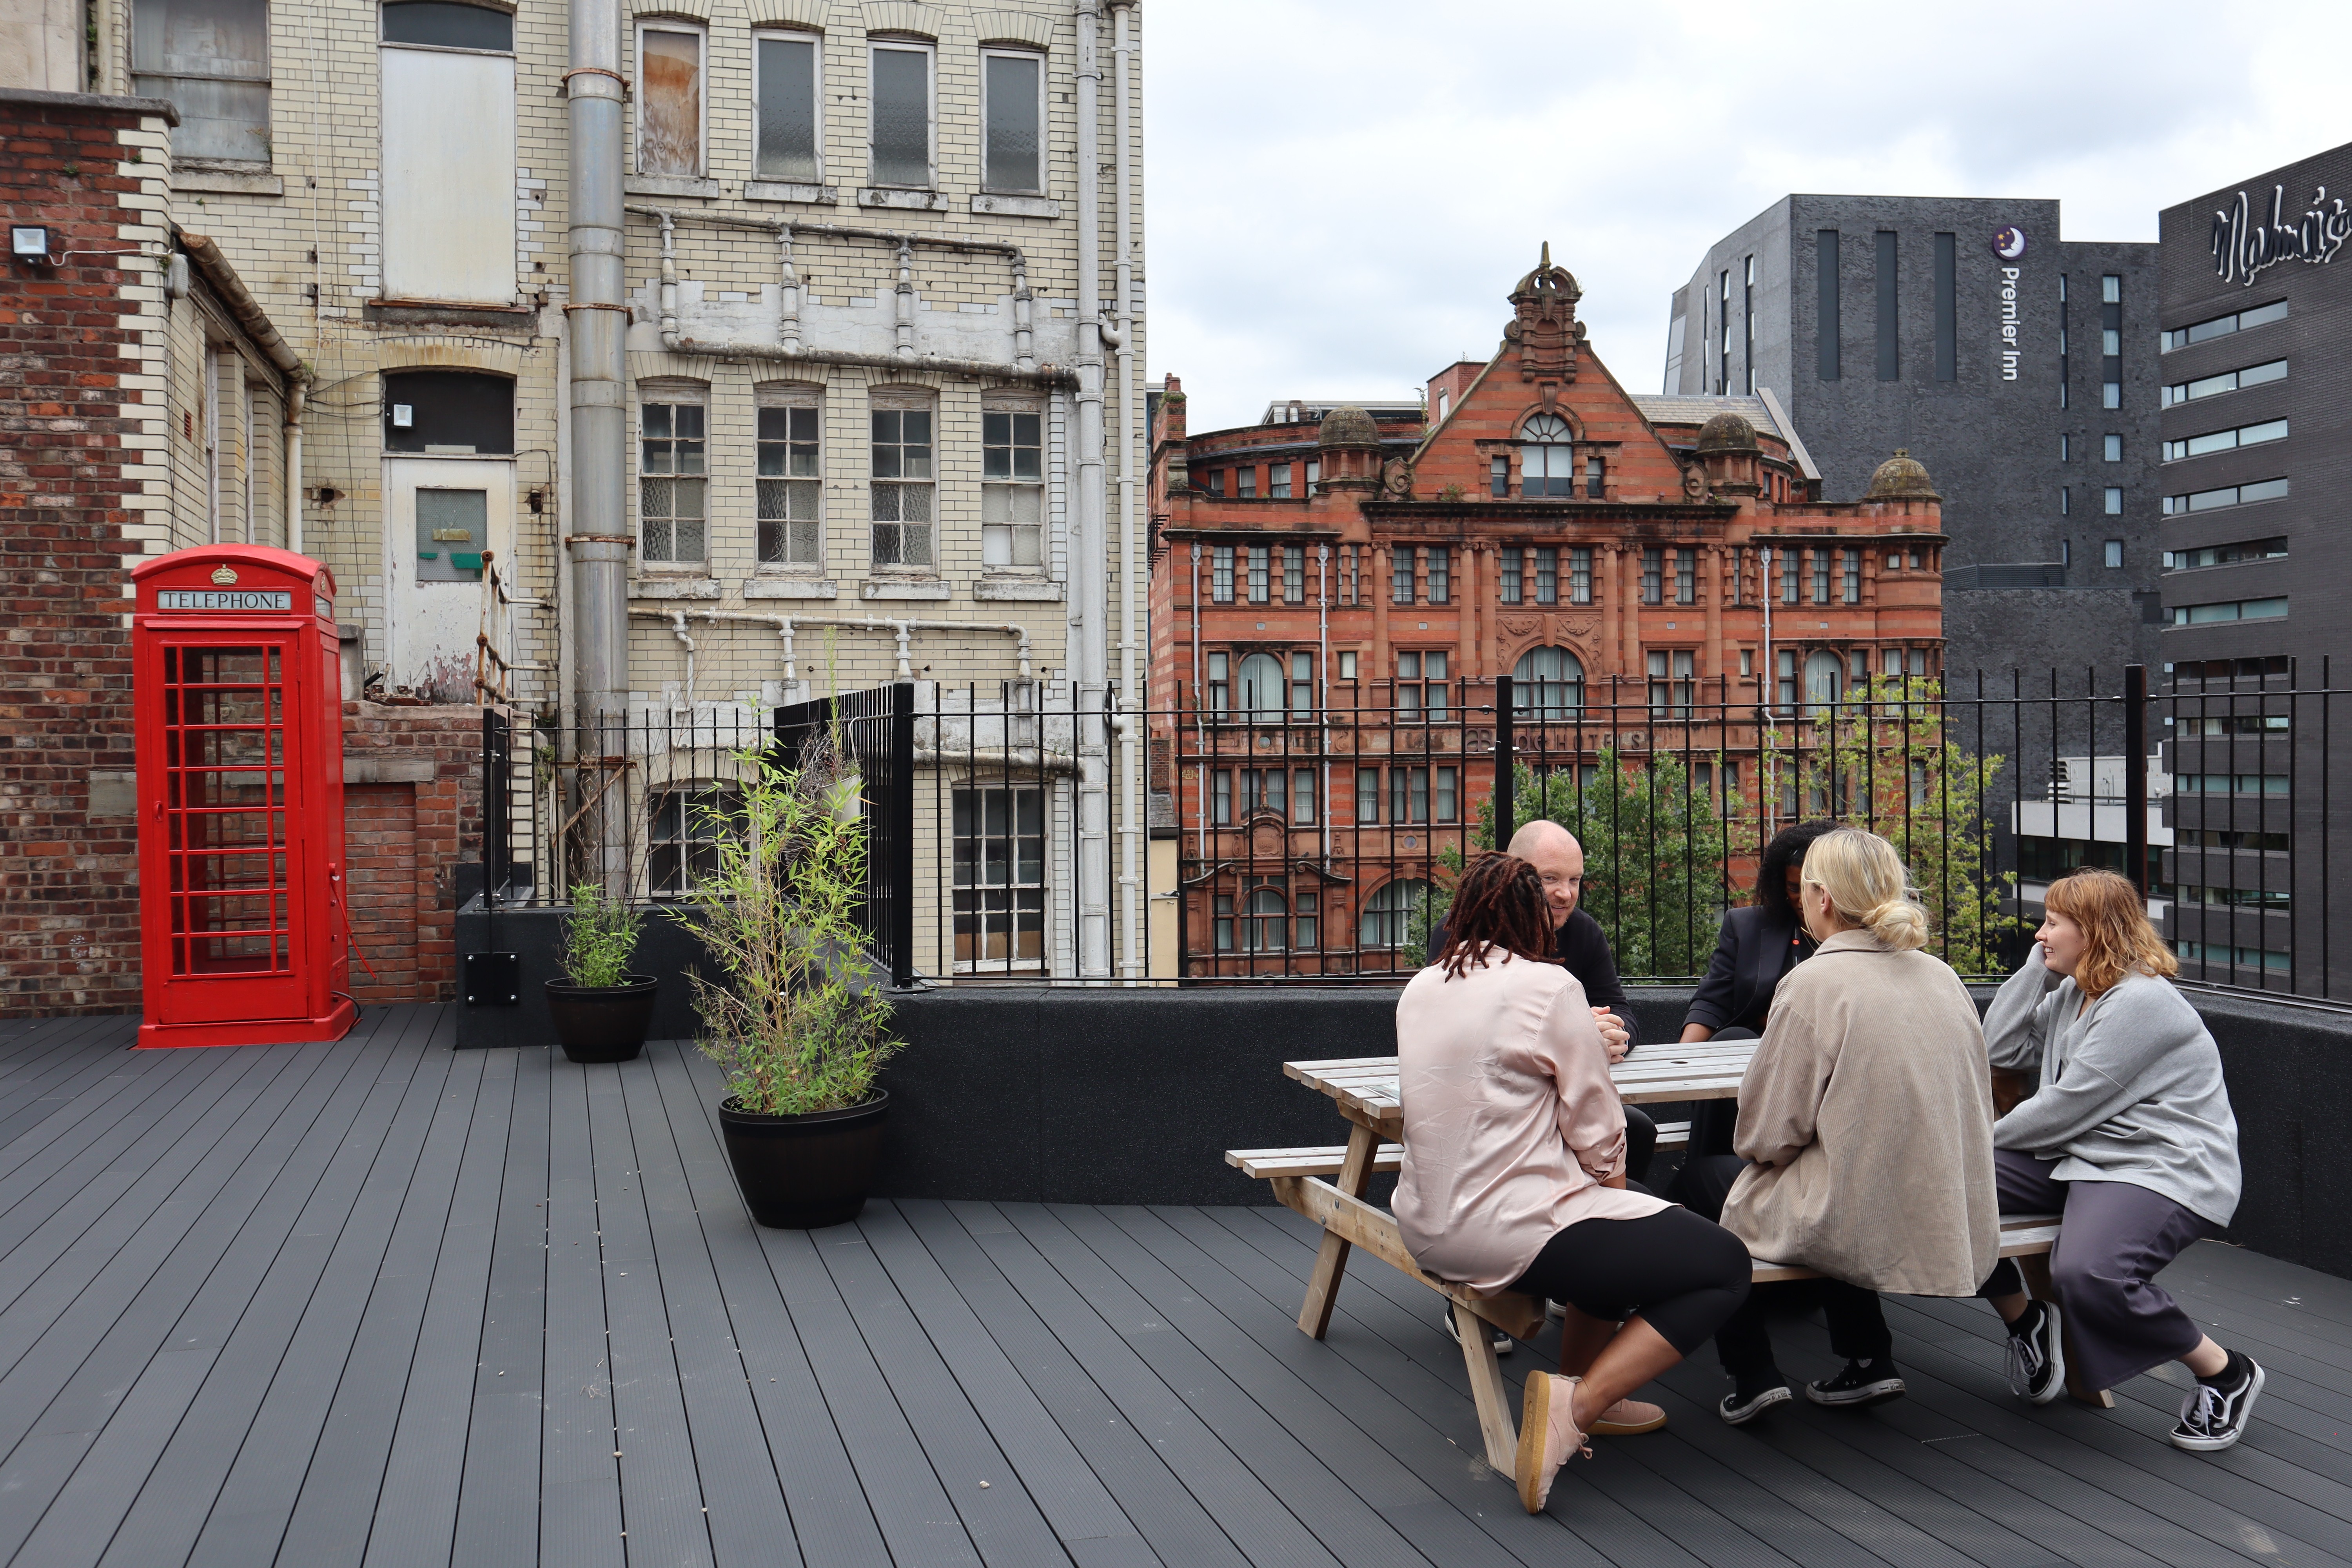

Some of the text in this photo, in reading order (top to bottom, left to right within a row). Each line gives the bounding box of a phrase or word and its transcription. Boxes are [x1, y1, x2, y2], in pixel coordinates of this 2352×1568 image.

[2211, 185, 2352, 287] Malmaiso
[2001, 267, 2021, 381] Premier Inn
[163, 593, 285, 609] TELEPHONE
